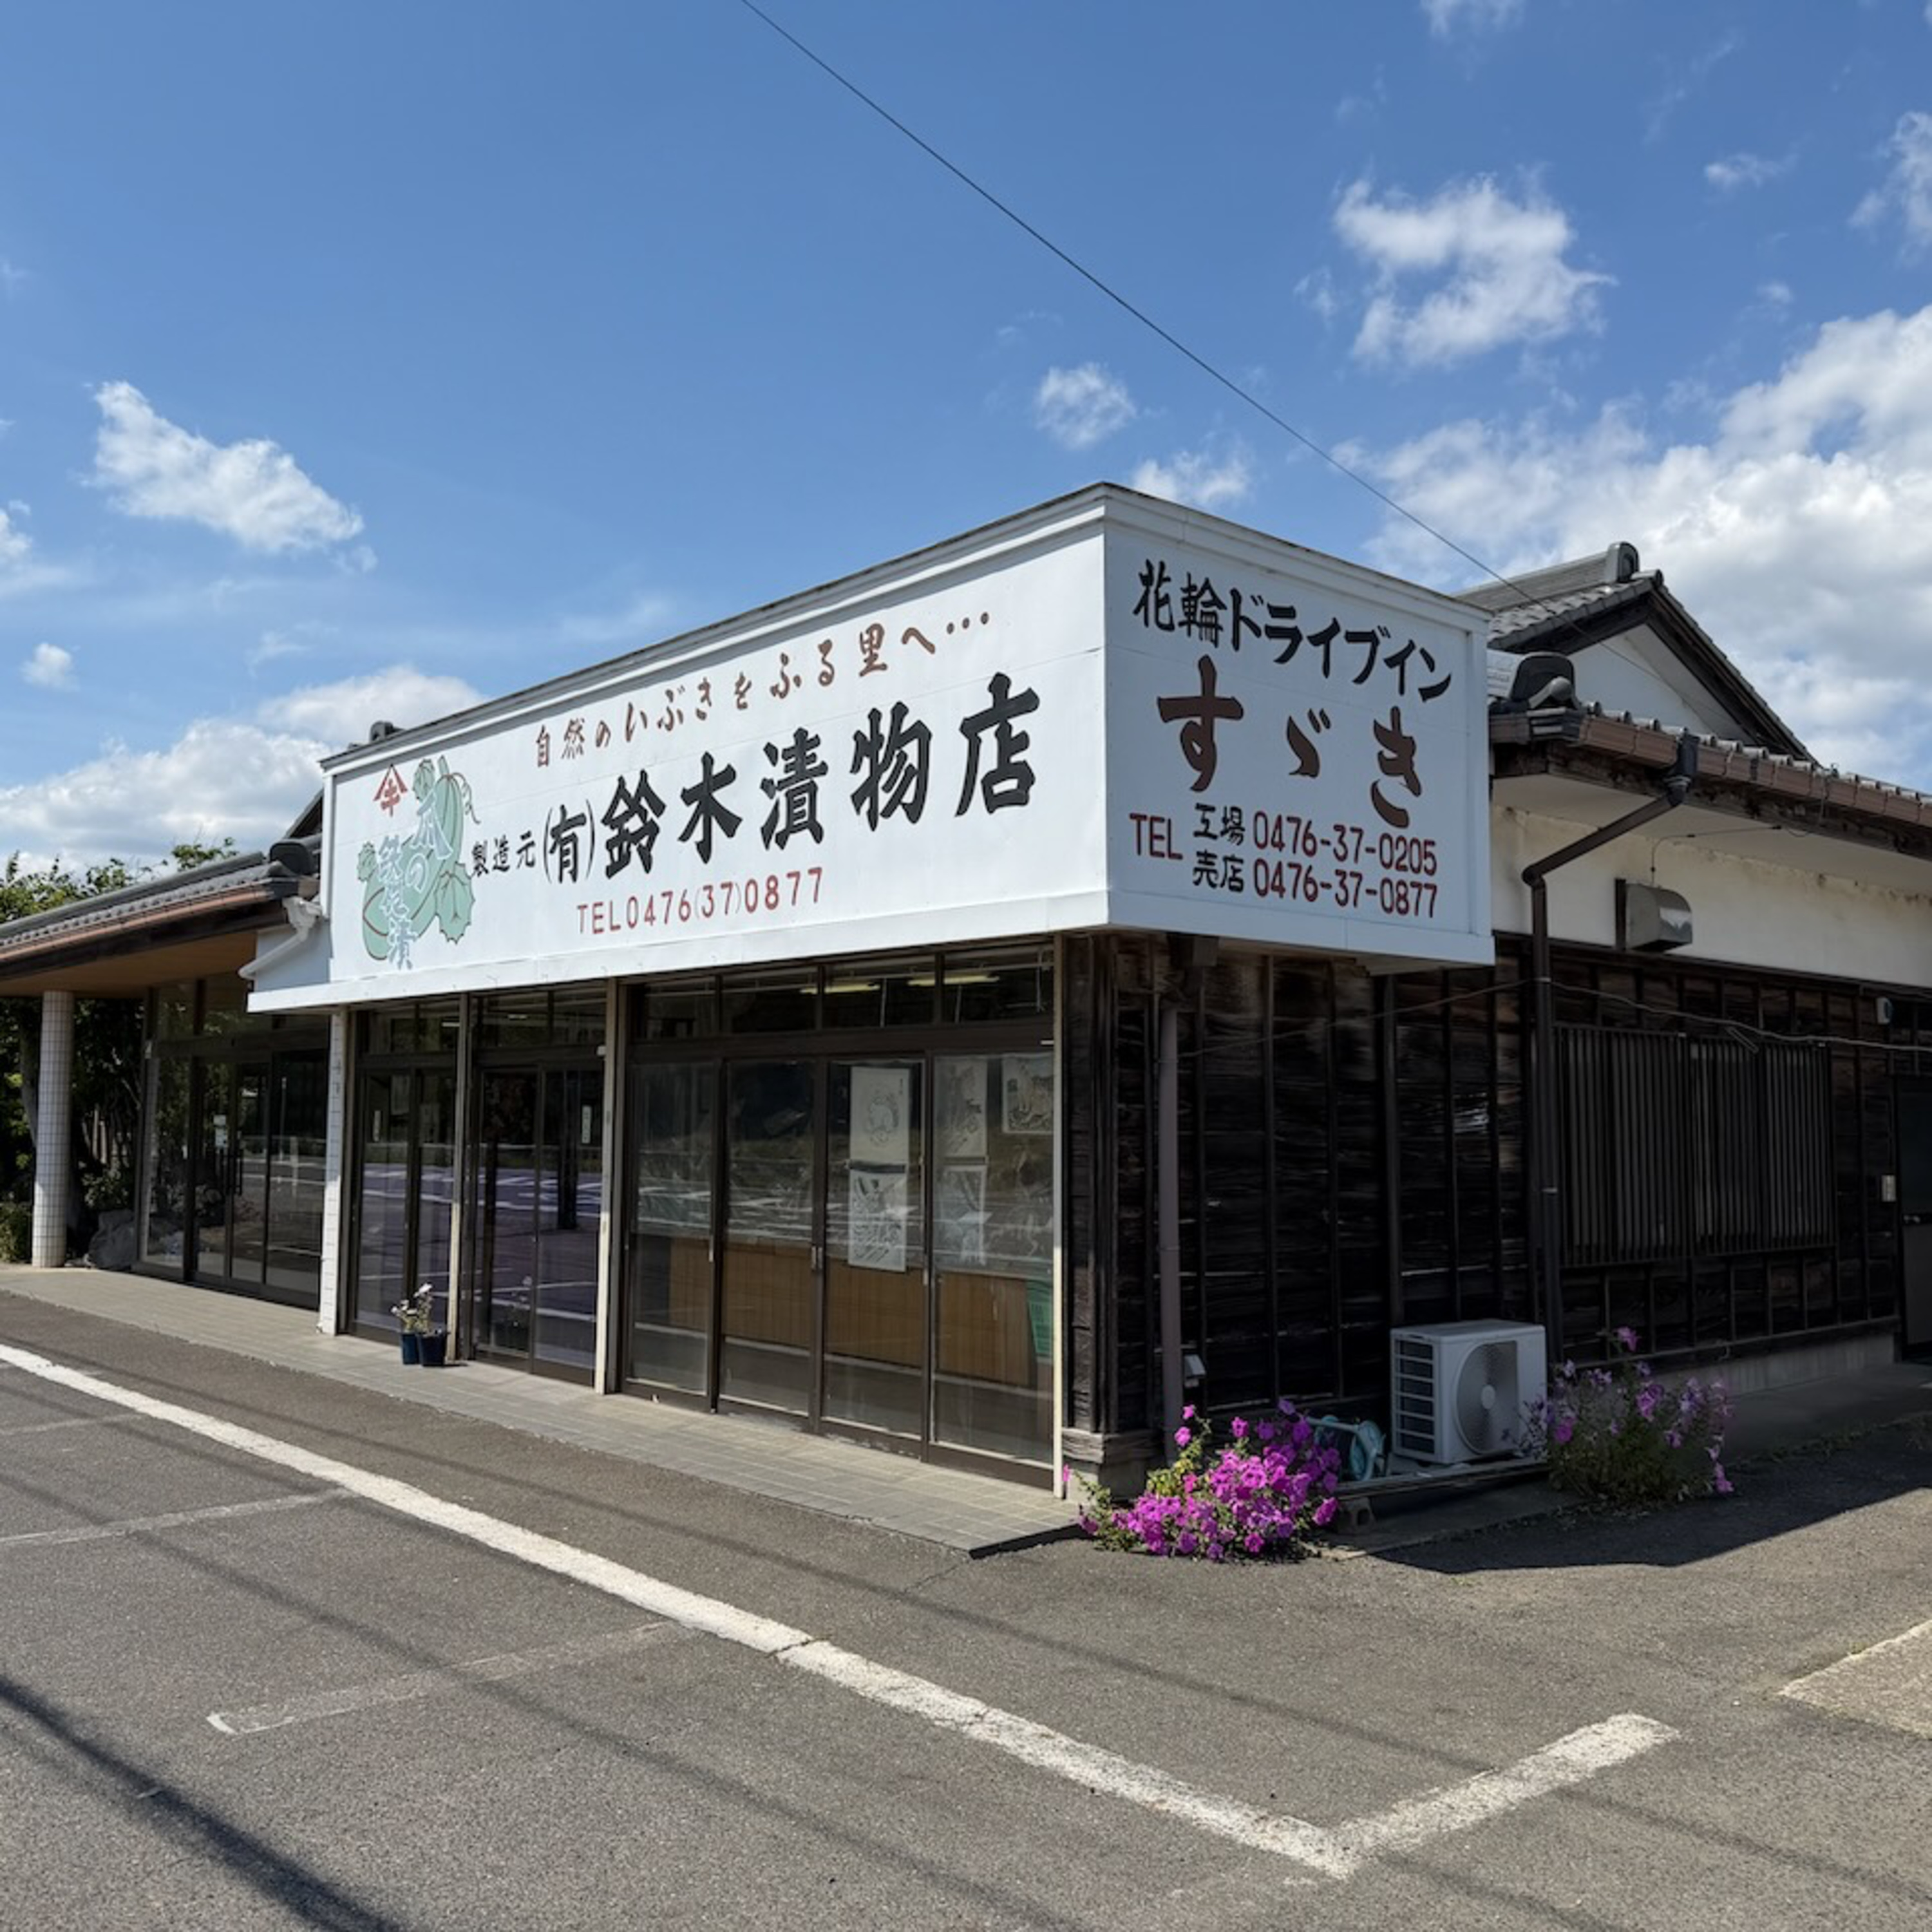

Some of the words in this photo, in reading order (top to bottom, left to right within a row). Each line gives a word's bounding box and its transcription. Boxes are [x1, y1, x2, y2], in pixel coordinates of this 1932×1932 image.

[1133, 559, 1452, 702] 花輪ドライブイン
[1130, 813, 1183, 860] TEL
[1193, 802, 1245, 846] 工場
[1253, 811, 1437, 876] 0476-37-0205
[1193, 849, 1245, 893] 売店
[1253, 858, 1437, 918] 0476-37-0877
